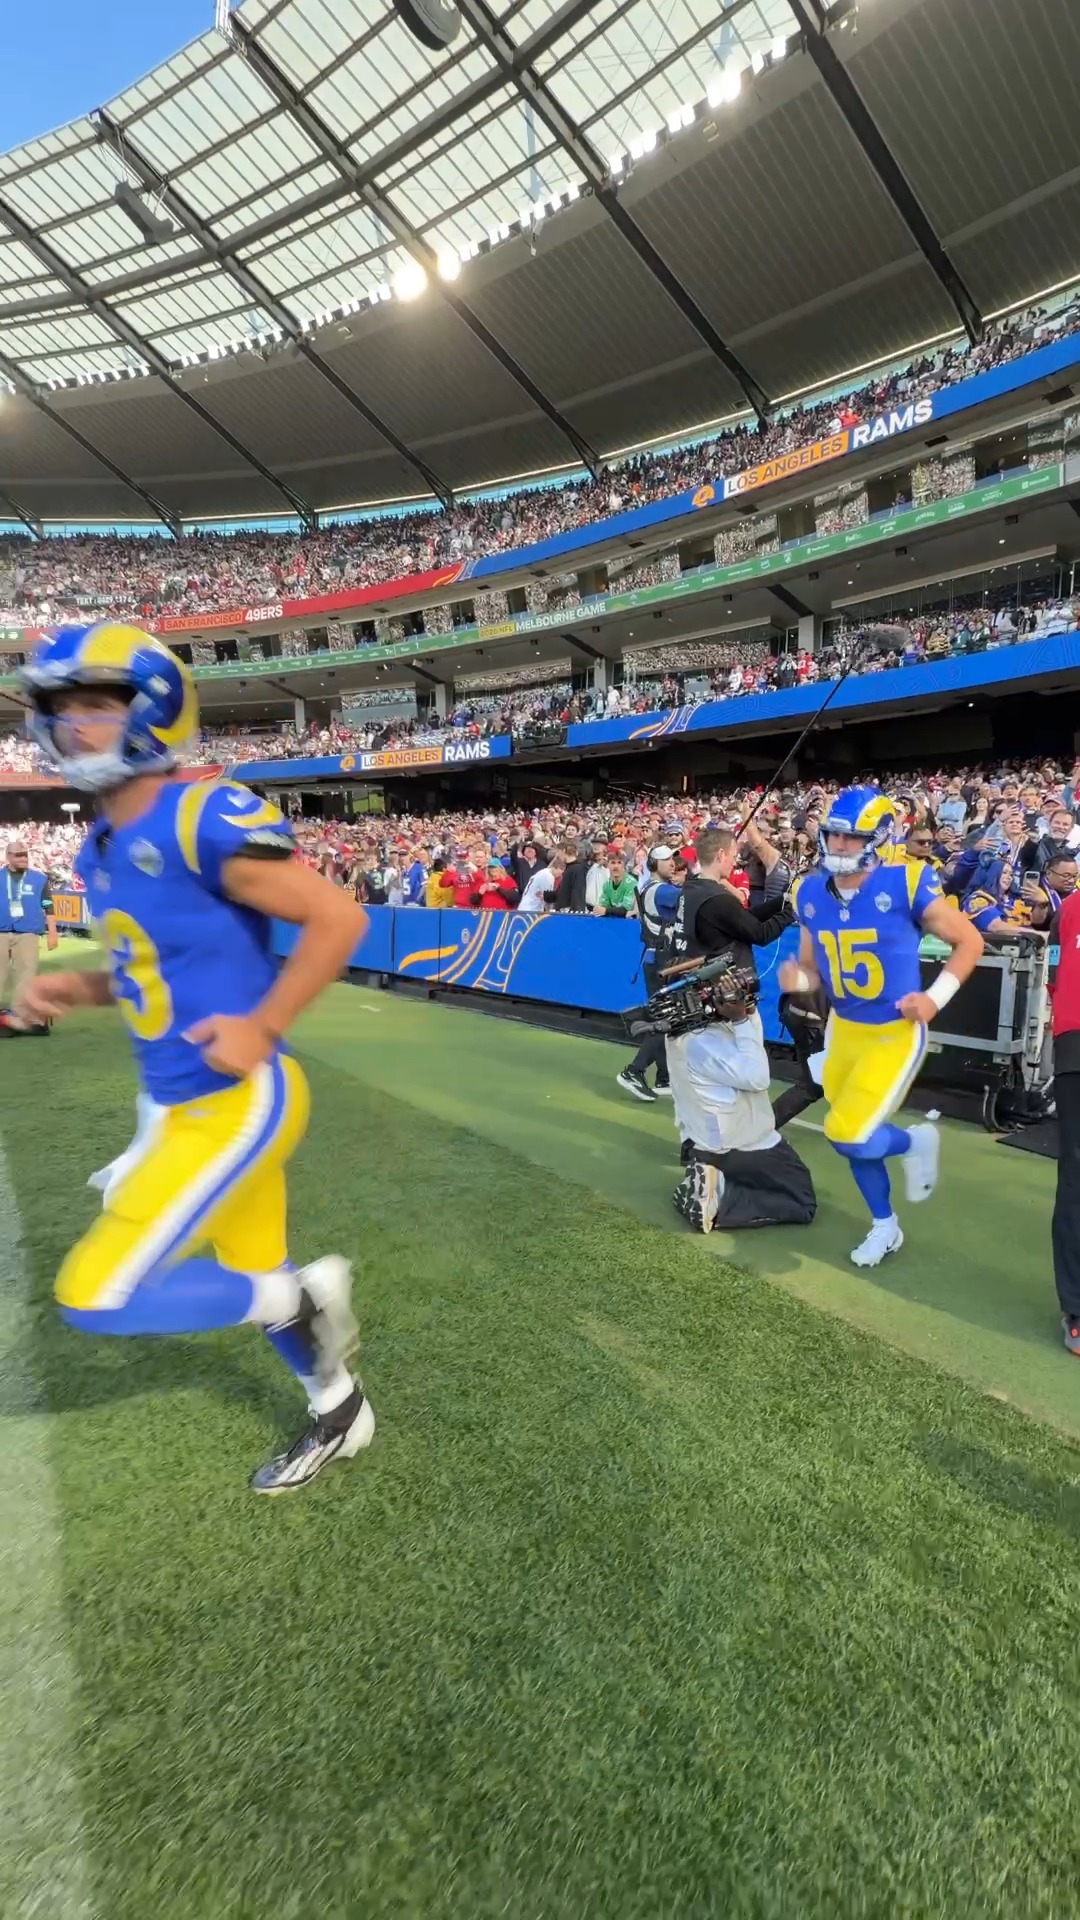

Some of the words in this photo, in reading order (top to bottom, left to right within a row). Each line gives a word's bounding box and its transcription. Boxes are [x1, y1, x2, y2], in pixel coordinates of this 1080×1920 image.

[727, 472, 758, 493] LOS
[762, 437, 843, 479] ANGELES
[852, 399, 933, 449] RAMS
[165, 621, 186, 630] SAN
[189, 612, 242, 628] FRANCISCO
[245, 604, 283, 622] 49ERS
[499, 624, 514, 634] NFL
[516, 610, 576, 632] MELBOURNE
[577, 602, 606, 618] GAME
[364, 754, 385, 767] LOS
[387, 749, 439, 765] ANGELES
[445, 741, 491, 761] RAMS
[57, 899, 78, 918] NFL
[818, 928, 885, 1000] 15
